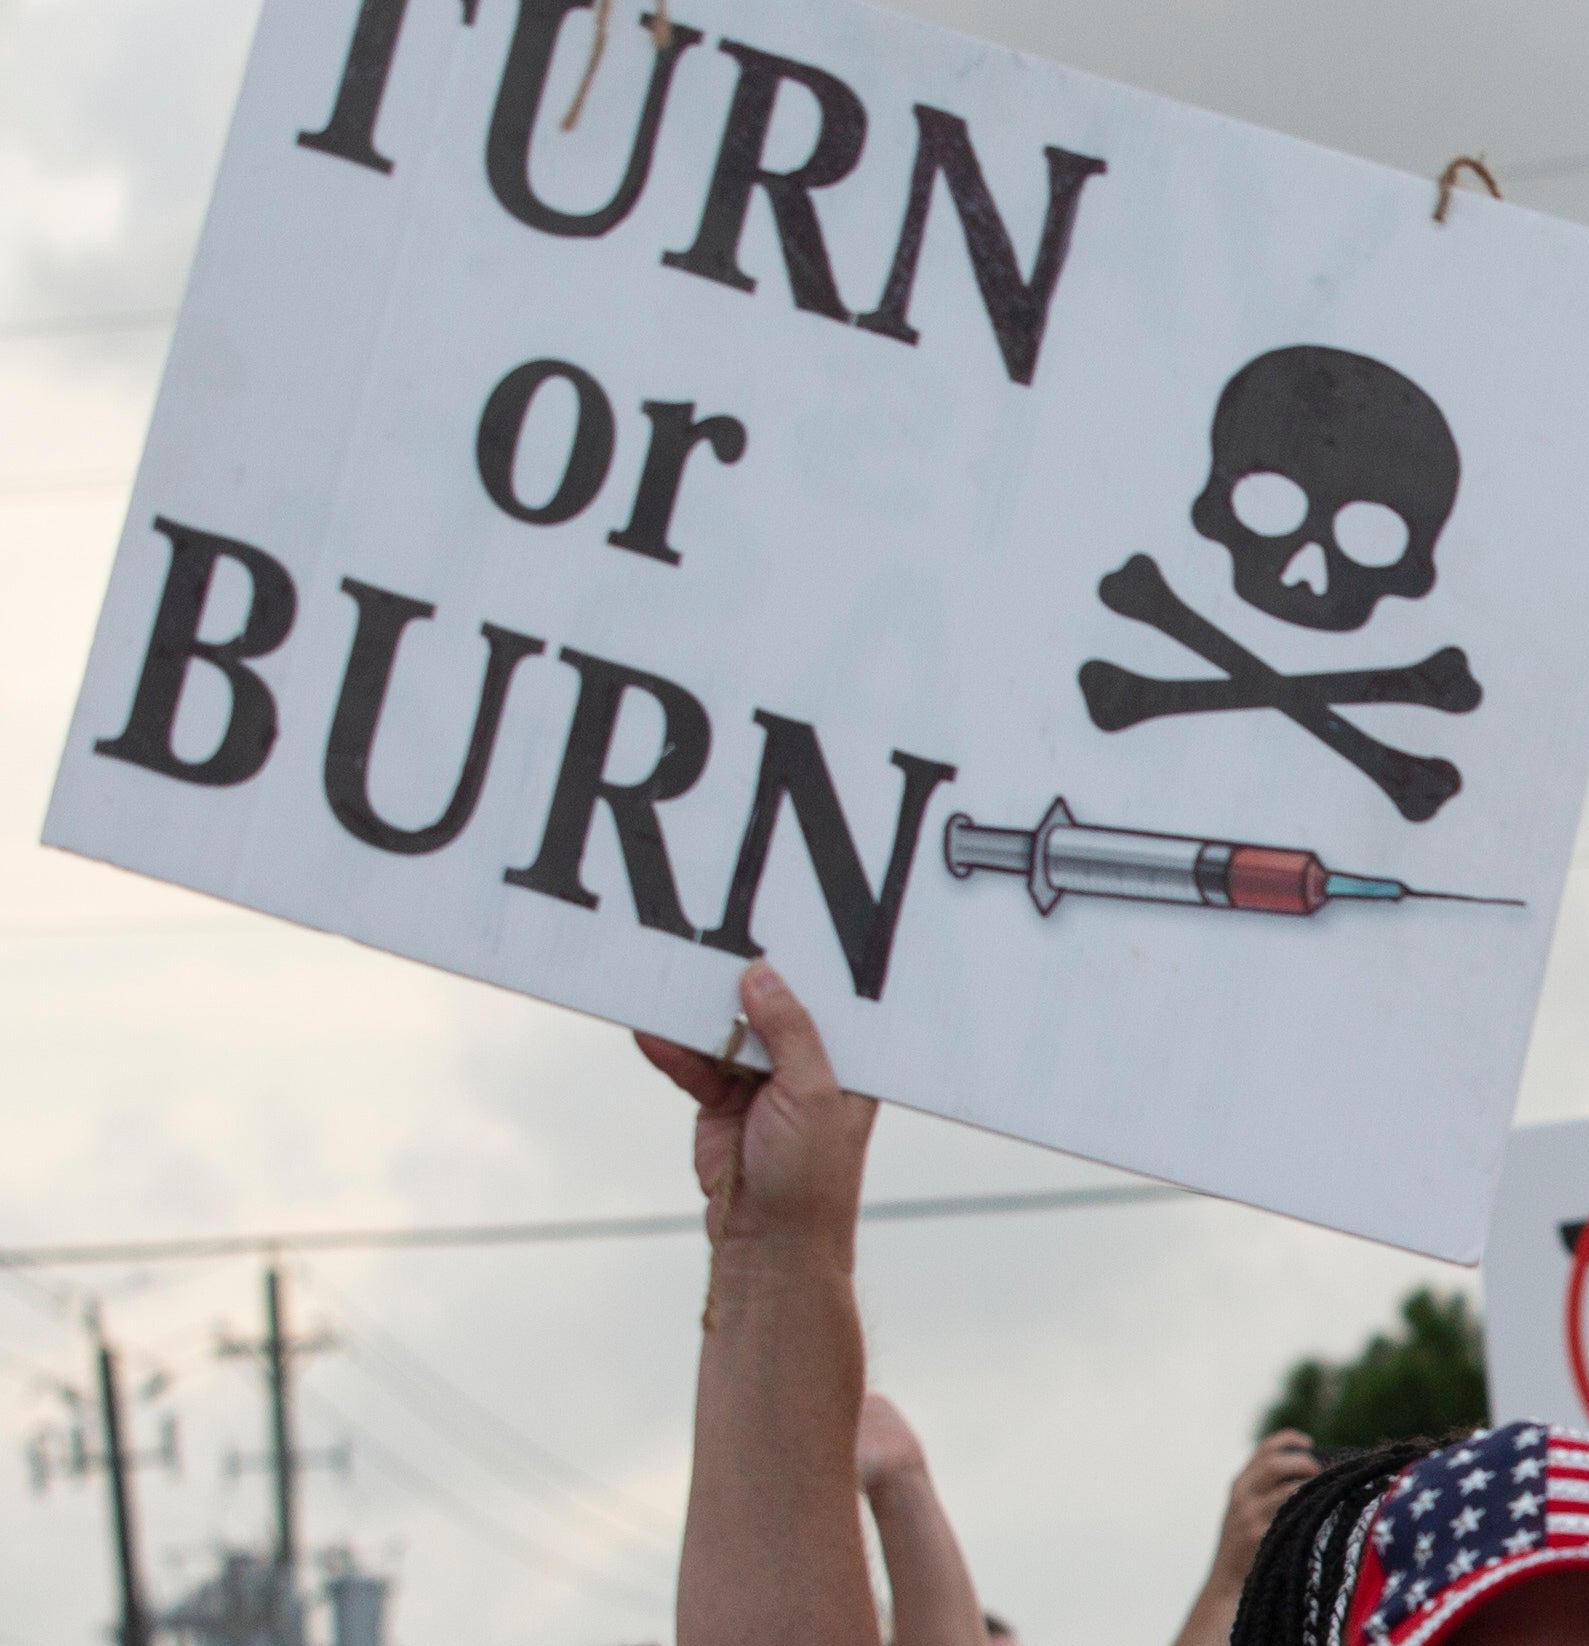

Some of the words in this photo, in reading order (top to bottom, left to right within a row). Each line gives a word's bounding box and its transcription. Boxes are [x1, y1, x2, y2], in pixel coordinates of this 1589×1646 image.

[298, 0, 1105, 386] TURN
[474, 358, 748, 565] or
[93, 517, 955, 1000] BURN
